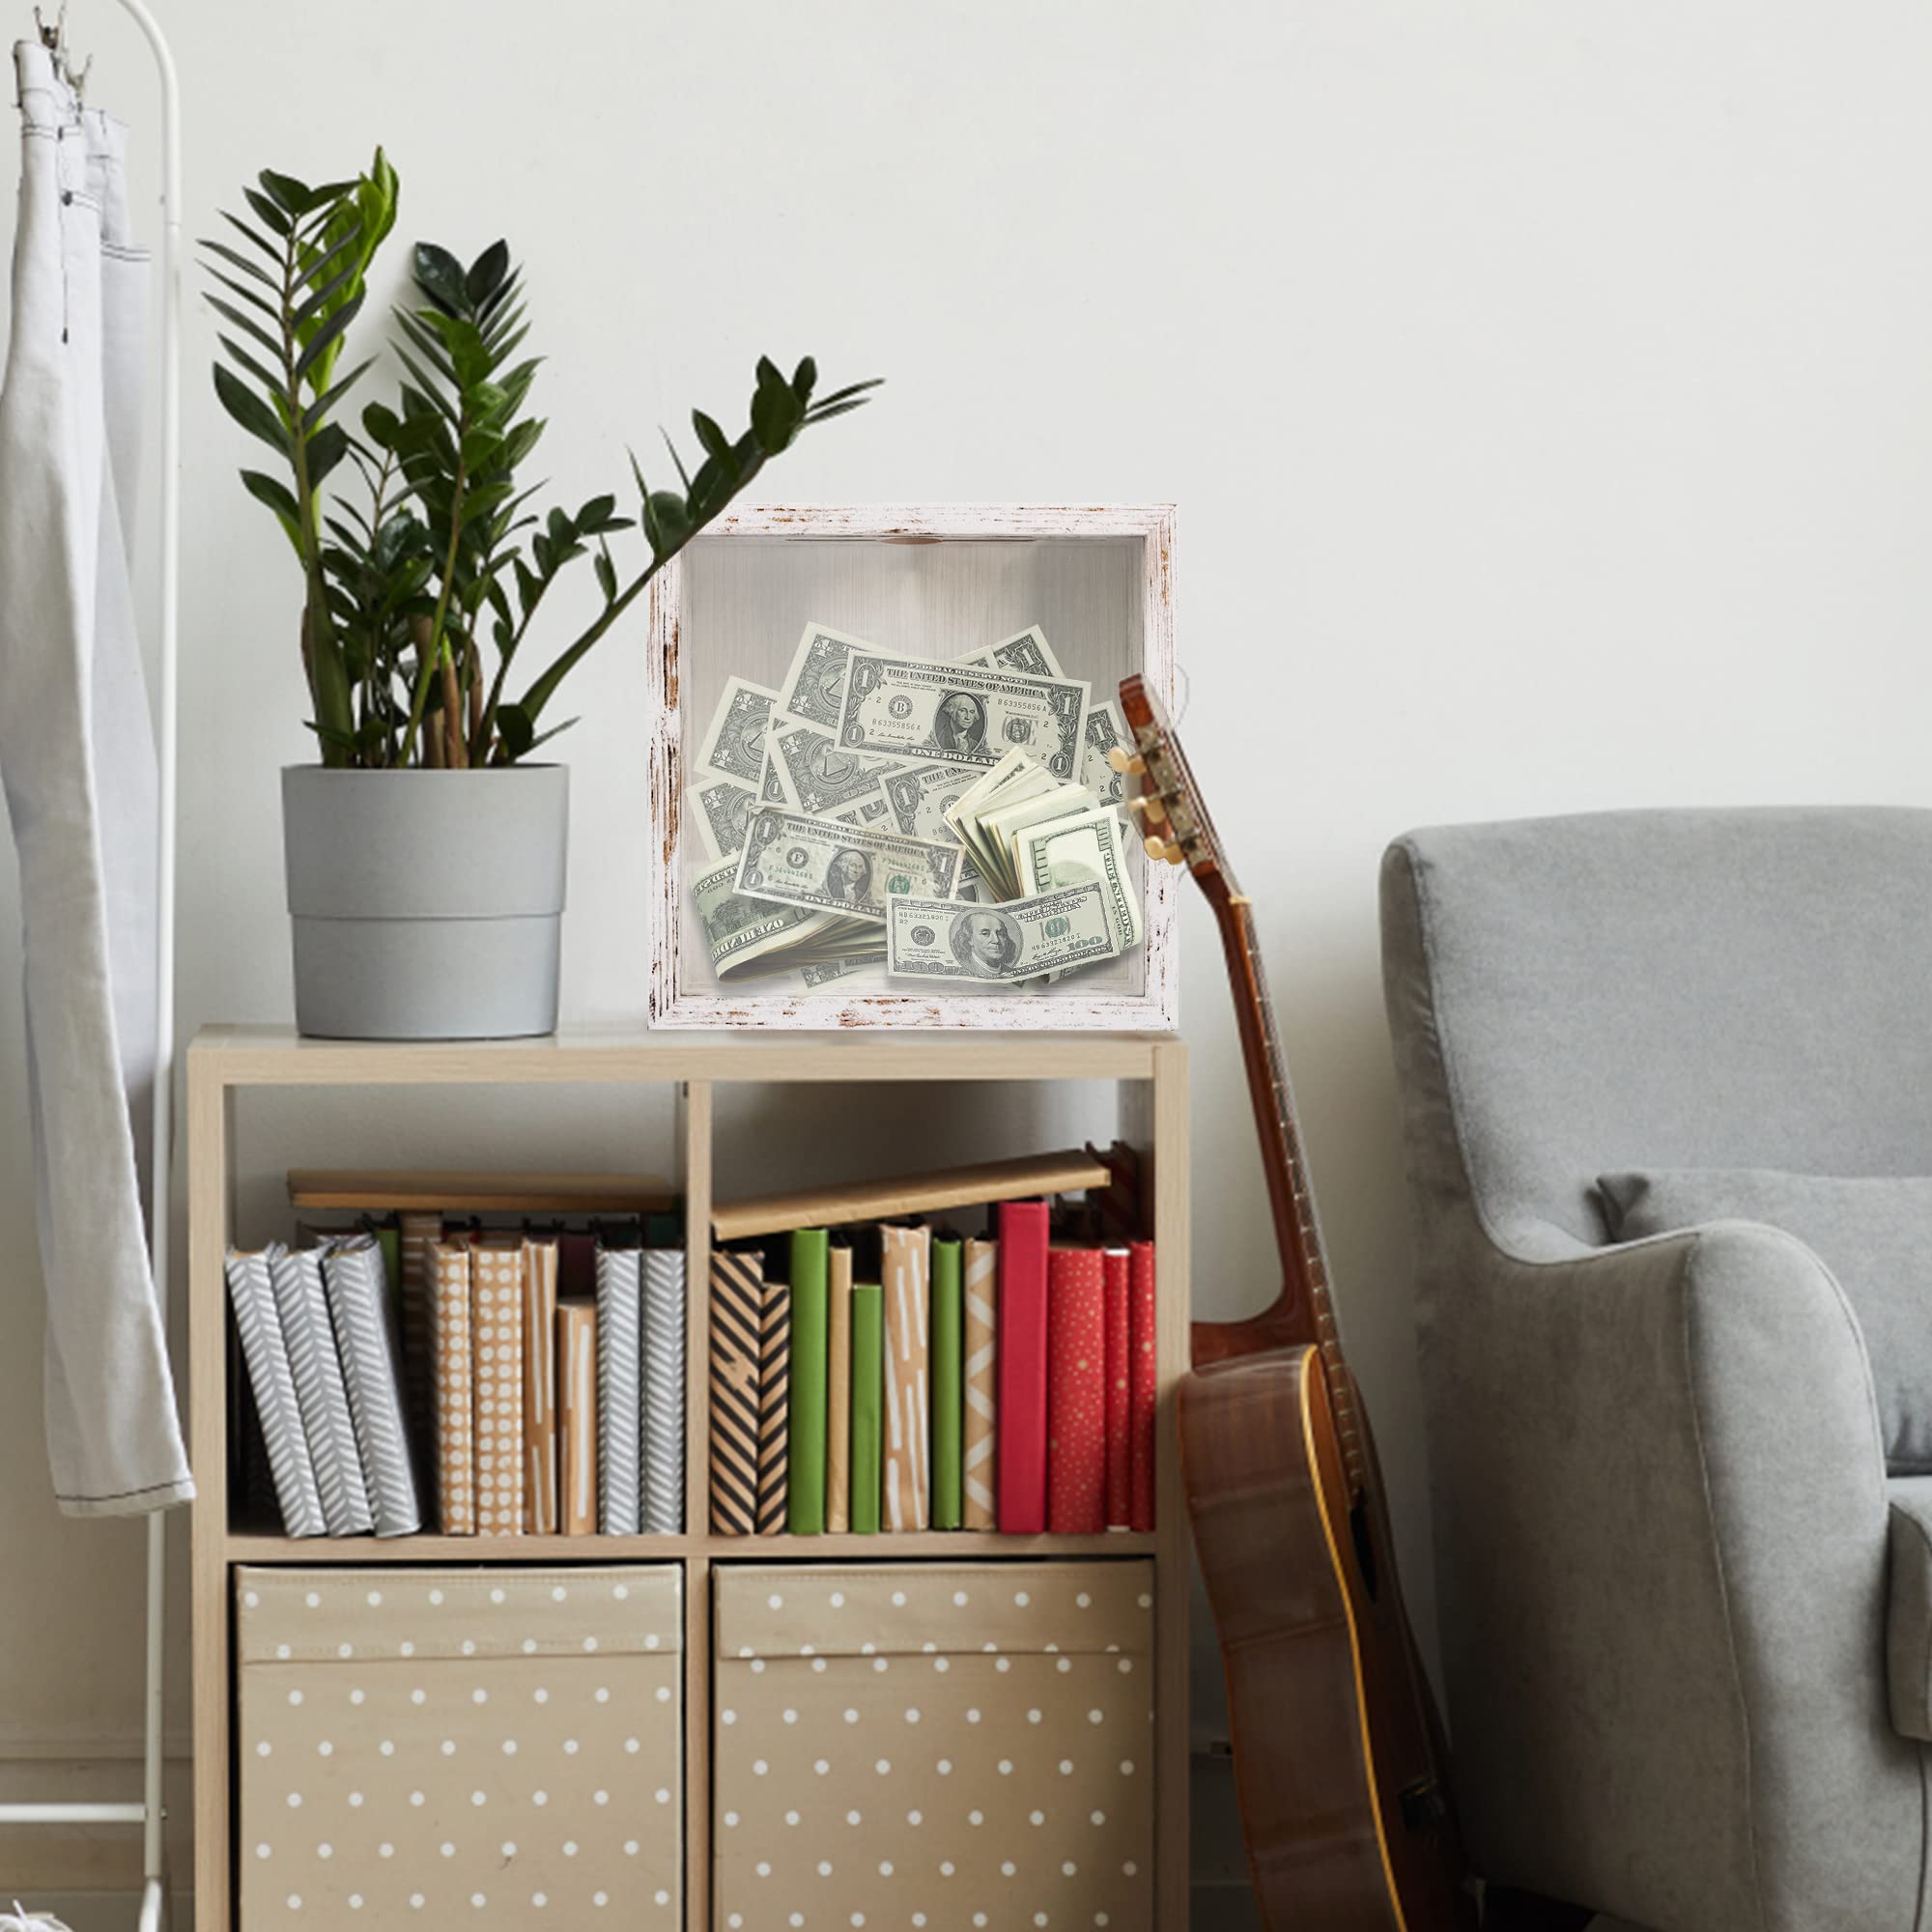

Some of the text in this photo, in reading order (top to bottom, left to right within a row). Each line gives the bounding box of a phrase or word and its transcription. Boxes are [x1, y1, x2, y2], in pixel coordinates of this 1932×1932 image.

[860, 669, 869, 688] 1
[887, 668, 908, 678] THE
[909, 671, 946, 684] UNITED
[947, 676, 984, 690] STATES
[985, 681, 999, 691] OF
[999, 684, 1046, 697] AMERICA
[897, 704, 905, 713] B
[1063, 696, 1071, 715] 1
[912, 748, 1001, 766] ONE DOLLAR
[922, 771, 945, 784] THE
[762, 821, 771, 838] 1
[787, 822, 806, 833] THE
[808, 826, 839, 841] UNITED
[840, 835, 873, 846] STATES
[873, 840, 885, 850] OF
[884, 842, 925, 858] AMERICA
[794, 853, 803, 863] F
[940, 857, 947, 873] 1
[805, 895, 882, 916] ONE DOLLAR
[1066, 935, 1103, 952] 100
